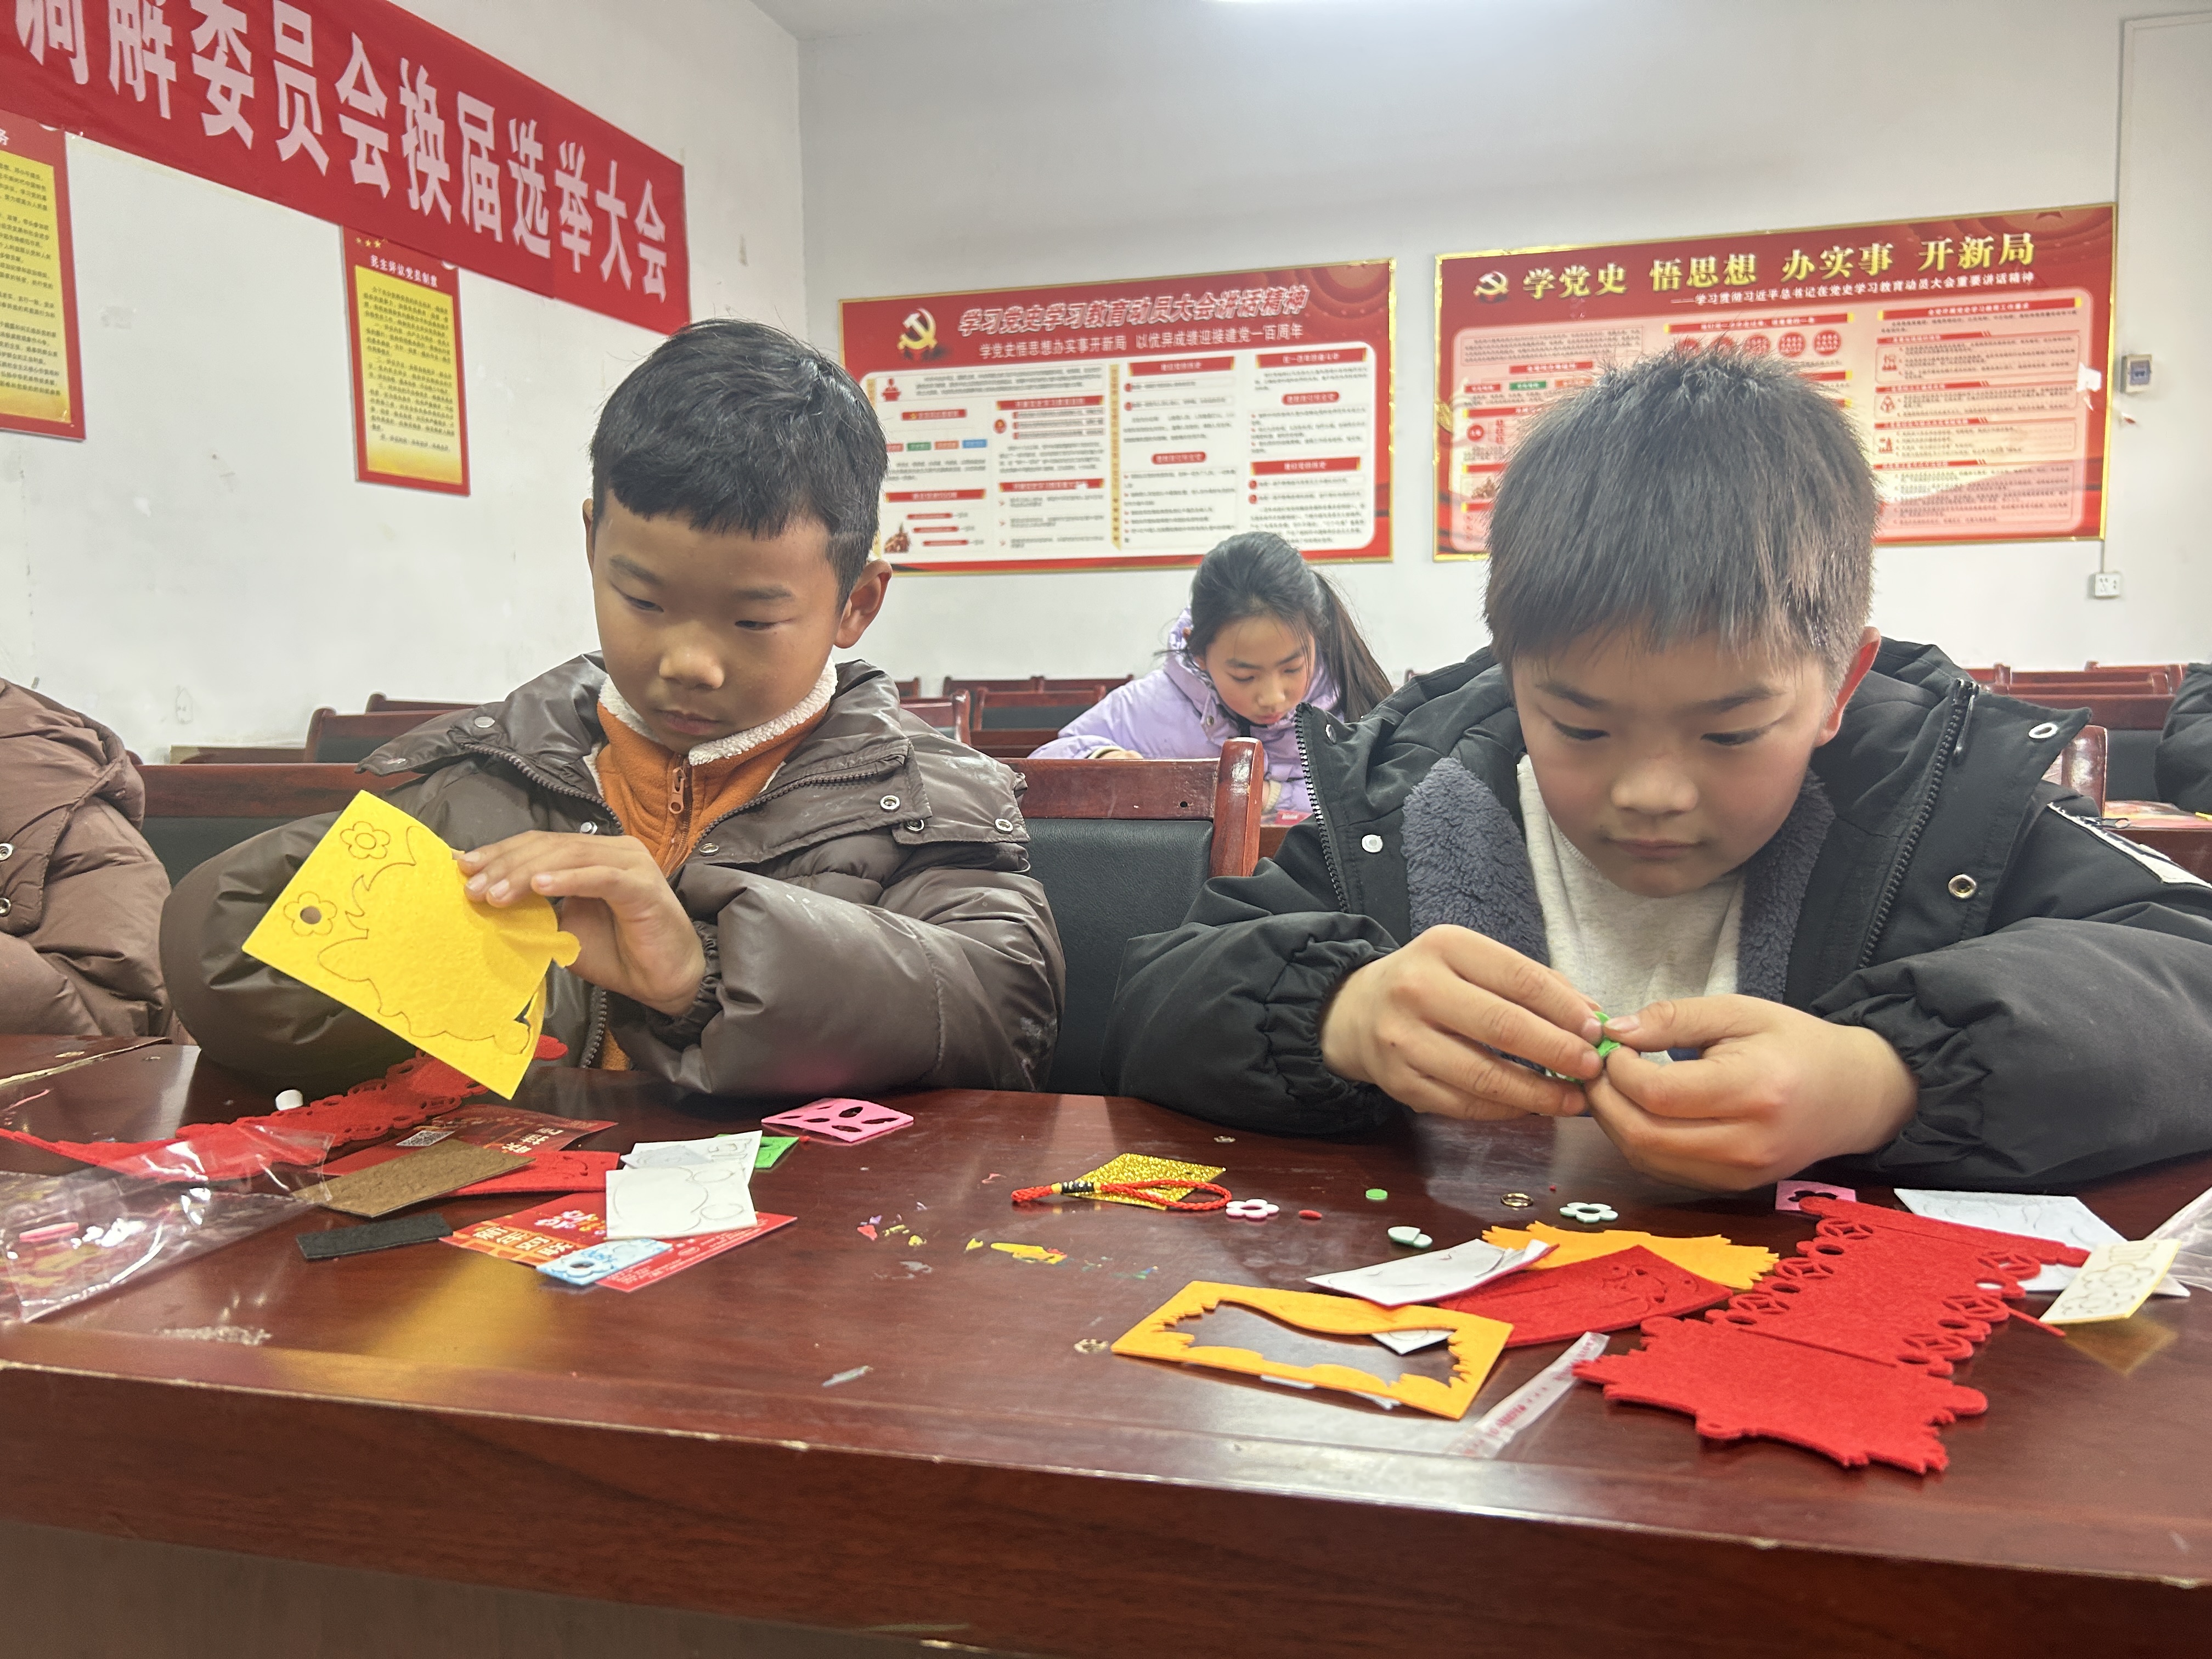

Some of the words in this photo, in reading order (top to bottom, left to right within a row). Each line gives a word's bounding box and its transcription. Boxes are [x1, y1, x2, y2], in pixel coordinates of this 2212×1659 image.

[1522, 262, 1628, 300] 学党史
[1649, 252, 1758, 292] 悟思想
[1780, 241, 1894, 284] 办实事
[1918, 232, 2035, 272] 开新局
[1136, 322, 1304, 350] 以优异成绩迎接建党一百周年
